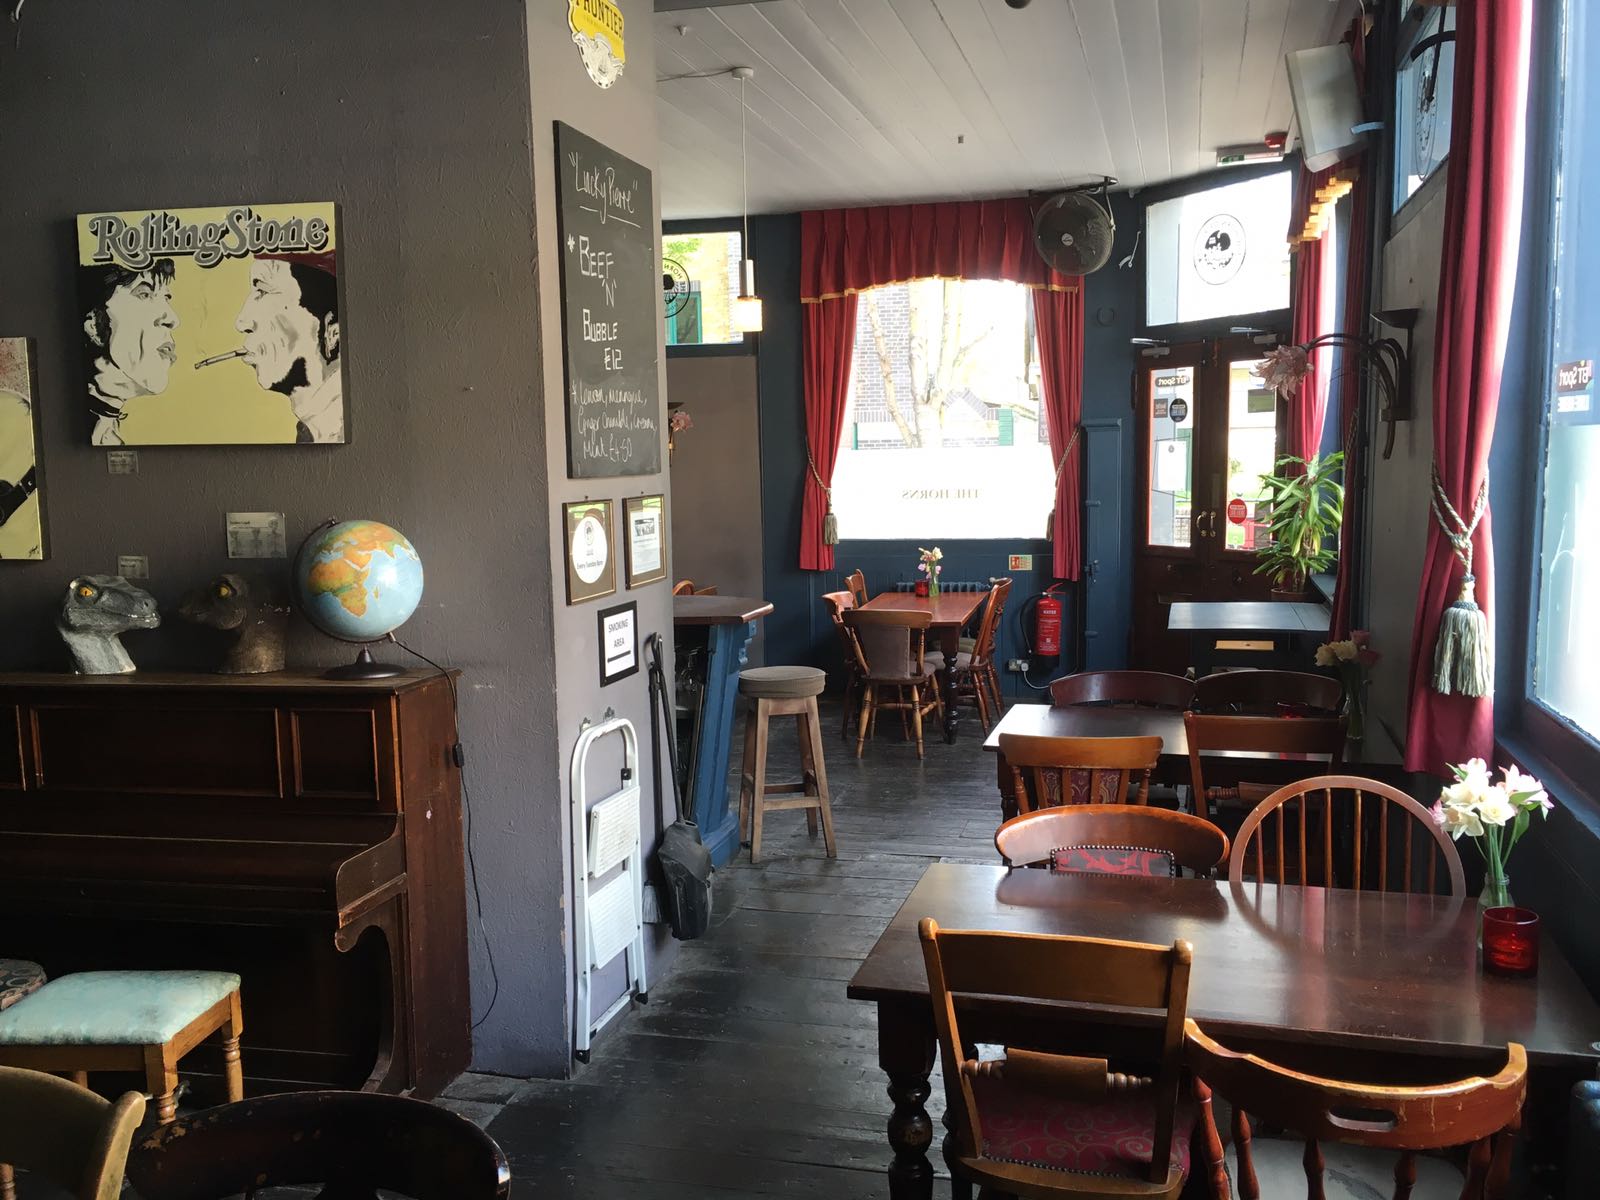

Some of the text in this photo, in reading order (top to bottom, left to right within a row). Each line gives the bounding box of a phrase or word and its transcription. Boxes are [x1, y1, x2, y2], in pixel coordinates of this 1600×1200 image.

[88, 205, 330, 271] Rolling Stone
[579, 235, 614, 279] BEEF
[582, 308, 618, 342] BUBBLE
[604, 347, 623, 370] £12
[608, 618, 629, 633] SMOKING
[613, 637, 625, 648] AREA
